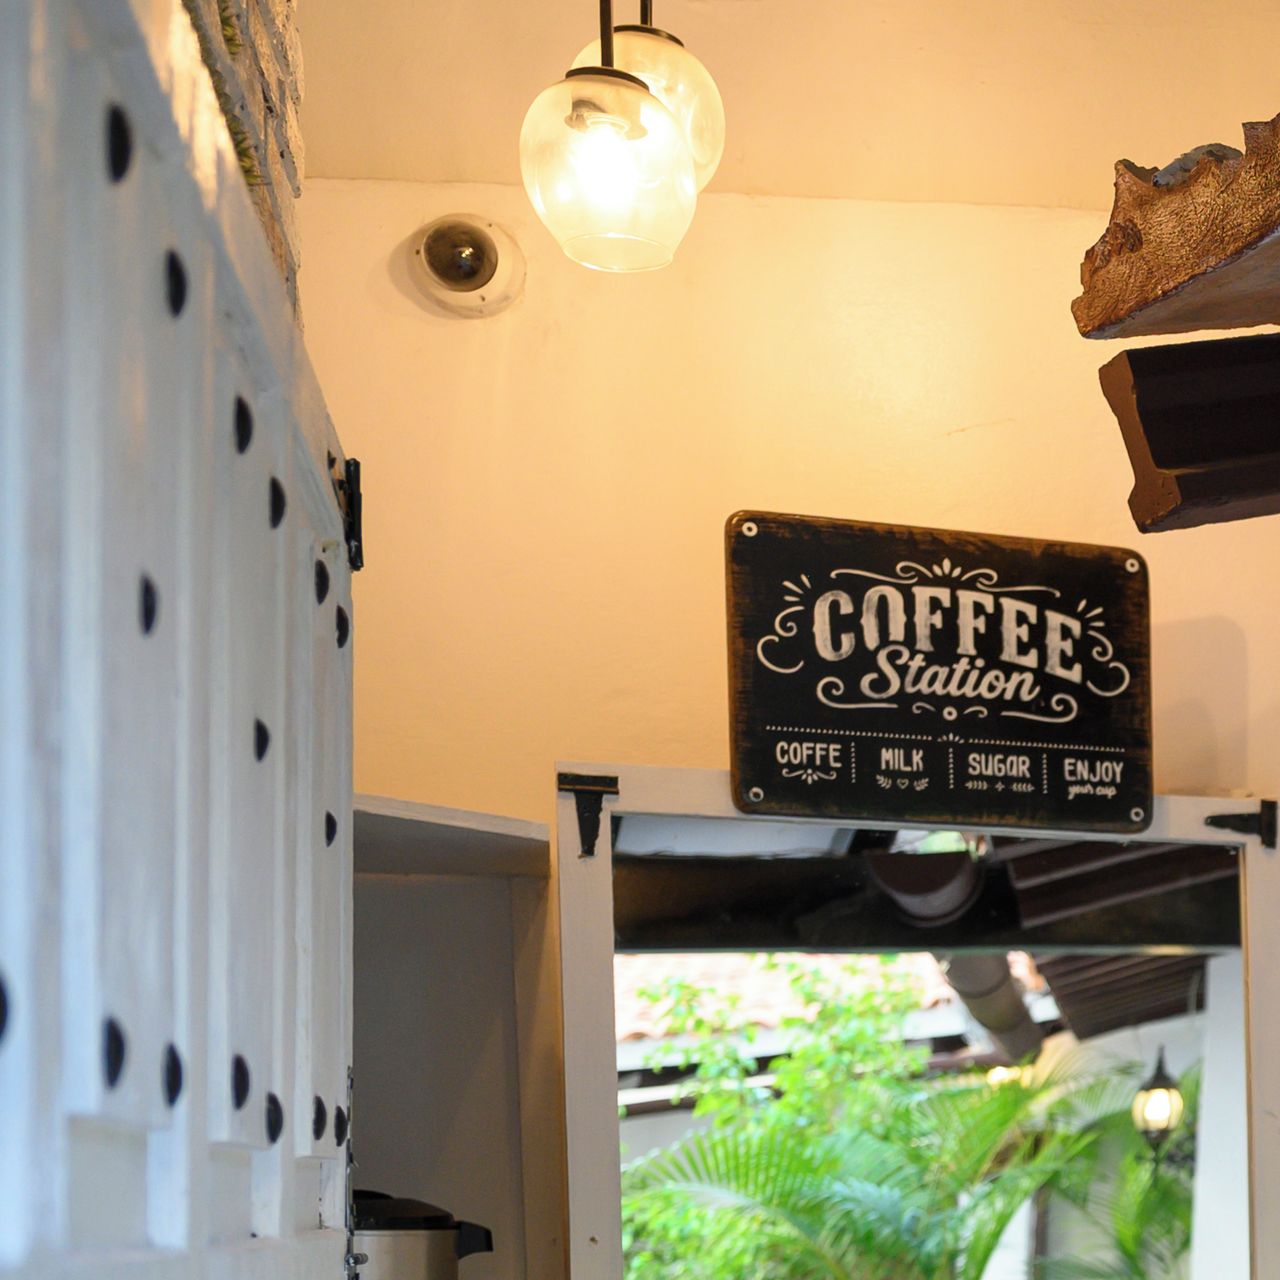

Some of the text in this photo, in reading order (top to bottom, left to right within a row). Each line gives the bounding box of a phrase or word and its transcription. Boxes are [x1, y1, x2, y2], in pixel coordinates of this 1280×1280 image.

[813, 585, 1083, 684] COFFEE
[860, 643, 1040, 703] Station
[776, 741, 842, 768] COFFE
[881, 747, 924, 772] MILK
[968, 752, 1031, 778] SUGAR
[1064, 757, 1124, 784] ENJOY
